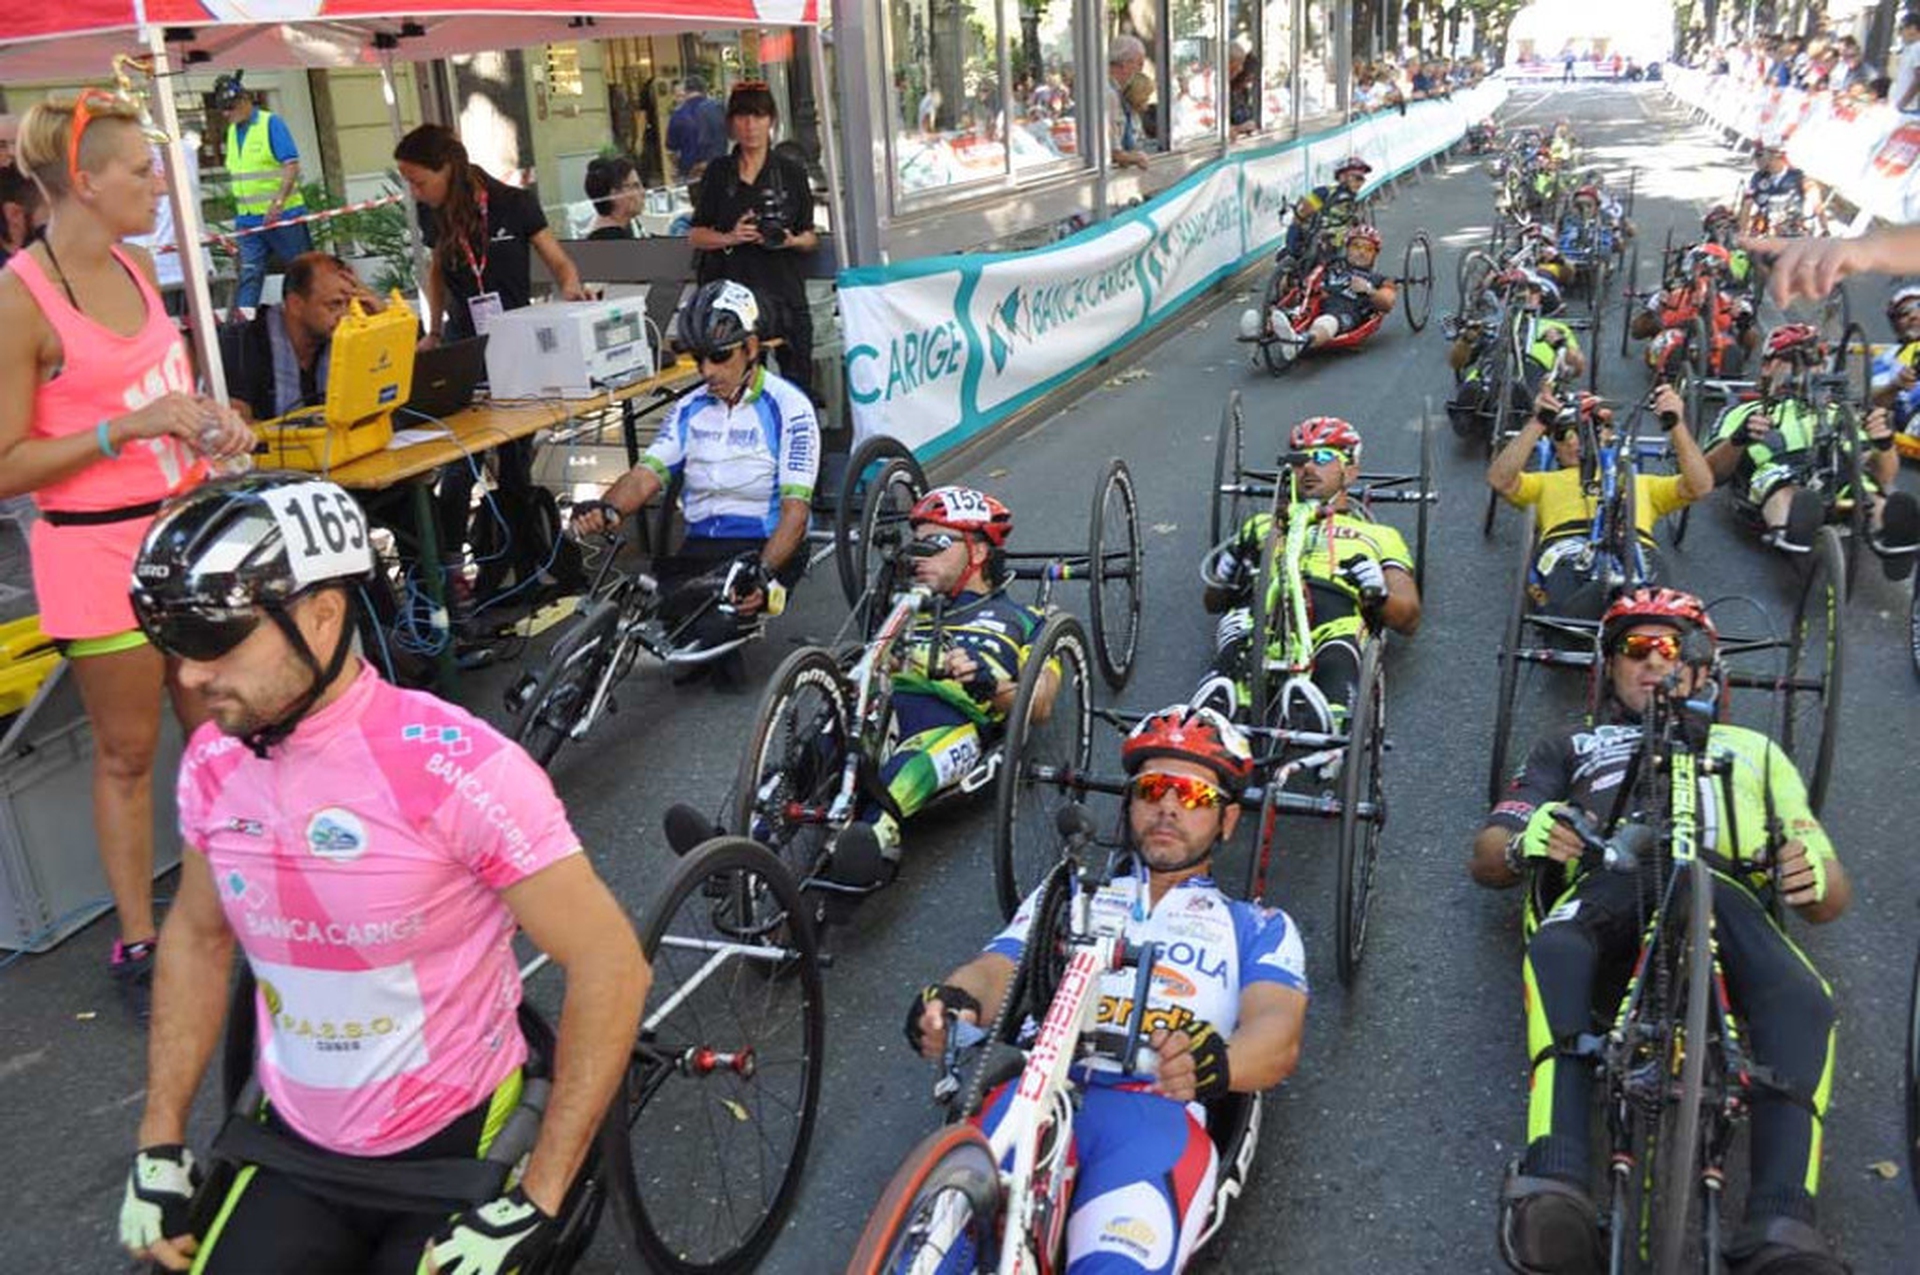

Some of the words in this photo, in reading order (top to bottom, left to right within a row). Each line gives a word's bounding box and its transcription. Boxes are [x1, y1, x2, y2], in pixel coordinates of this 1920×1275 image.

[845, 319, 962, 405] CARIGE
[284, 492, 364, 557] 165
[946, 489, 987, 512] 152
